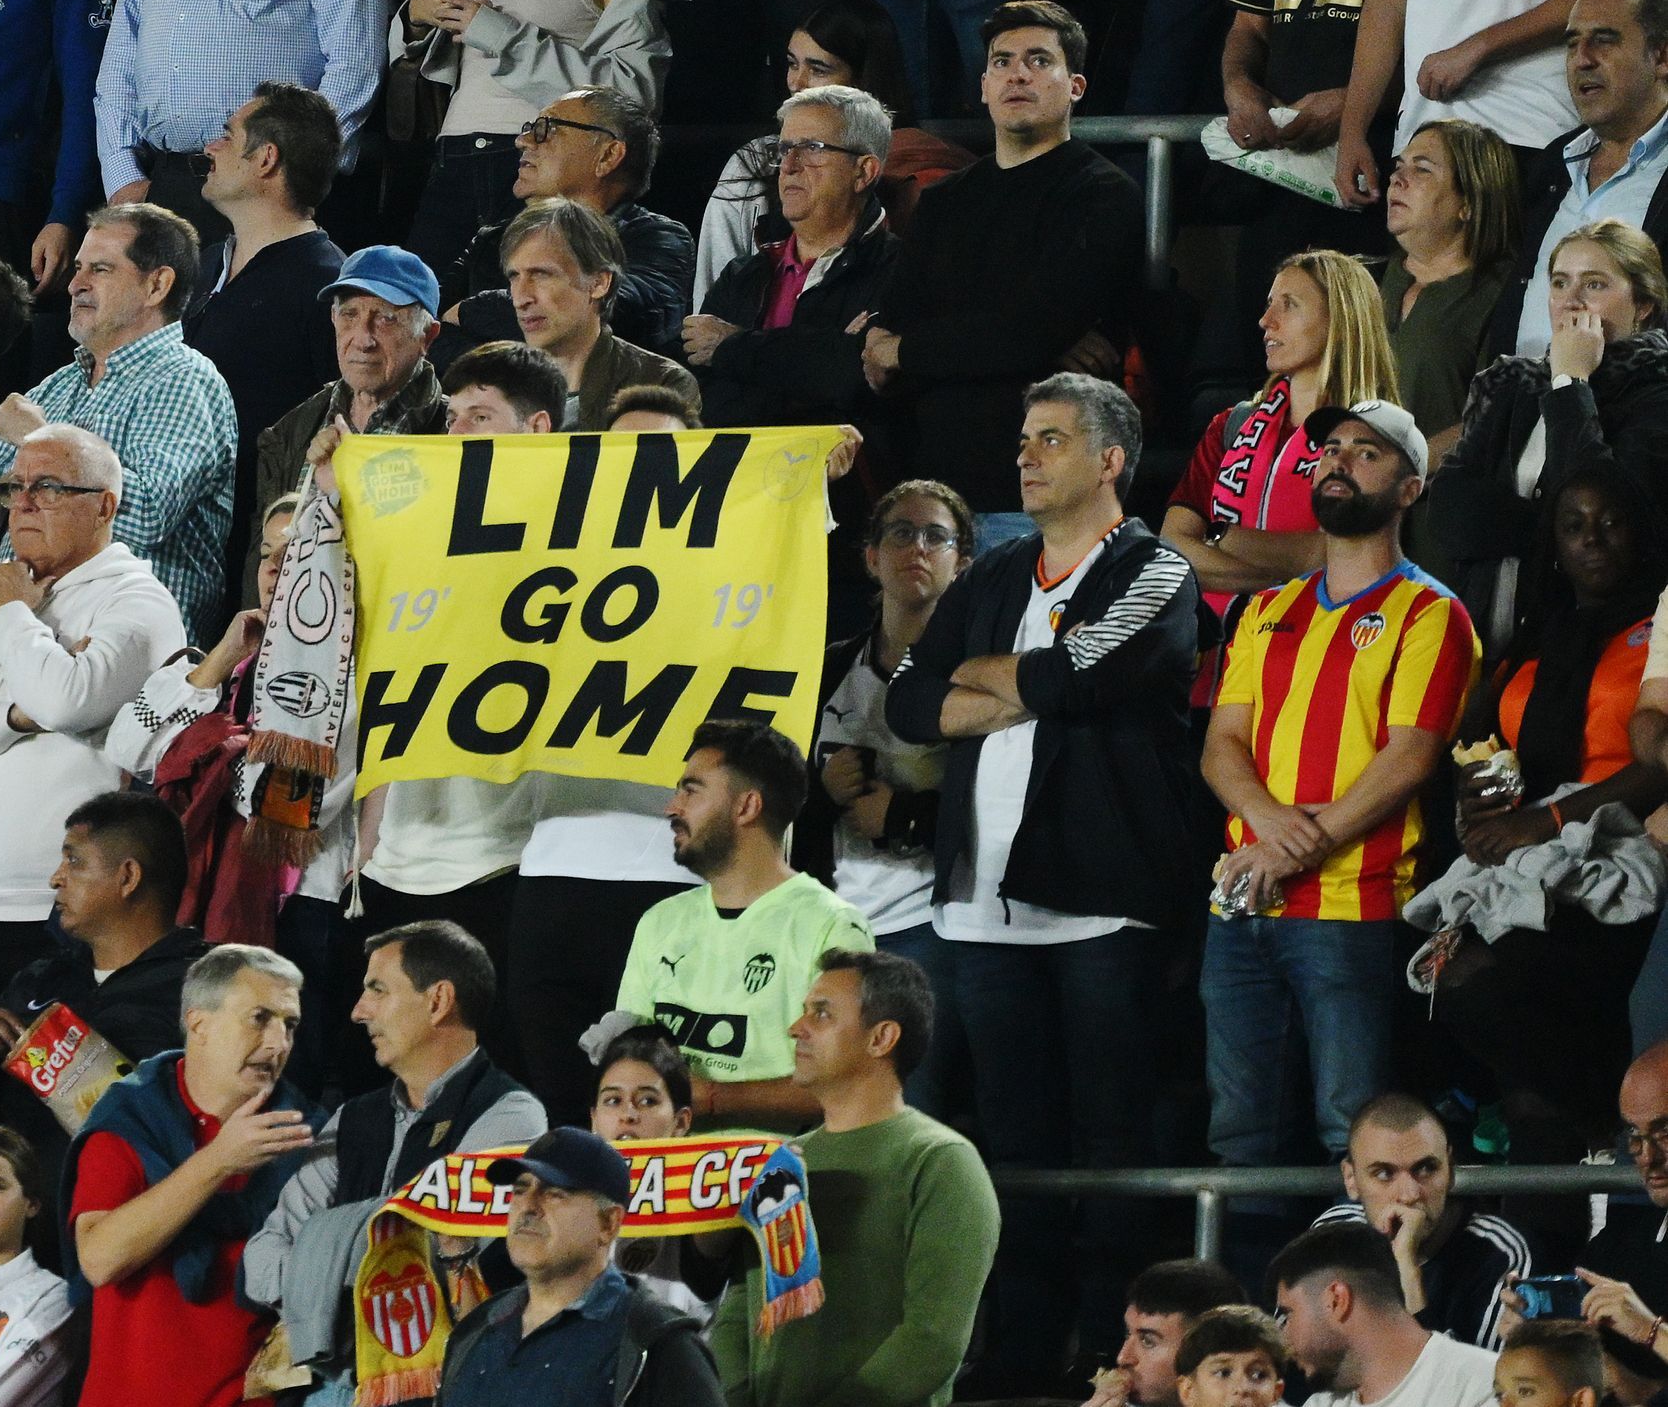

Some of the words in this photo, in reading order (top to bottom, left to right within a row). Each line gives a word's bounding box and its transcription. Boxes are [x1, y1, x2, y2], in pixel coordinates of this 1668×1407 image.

[1327, 8, 1360, 21] Group
[446, 432, 752, 557] LIM
[500, 564, 659, 645] GO
[362, 658, 799, 762] HOME
[705, 1052, 738, 1073] Group
[407, 1156, 667, 1217] ALEA
[690, 1144, 767, 1210] CF
